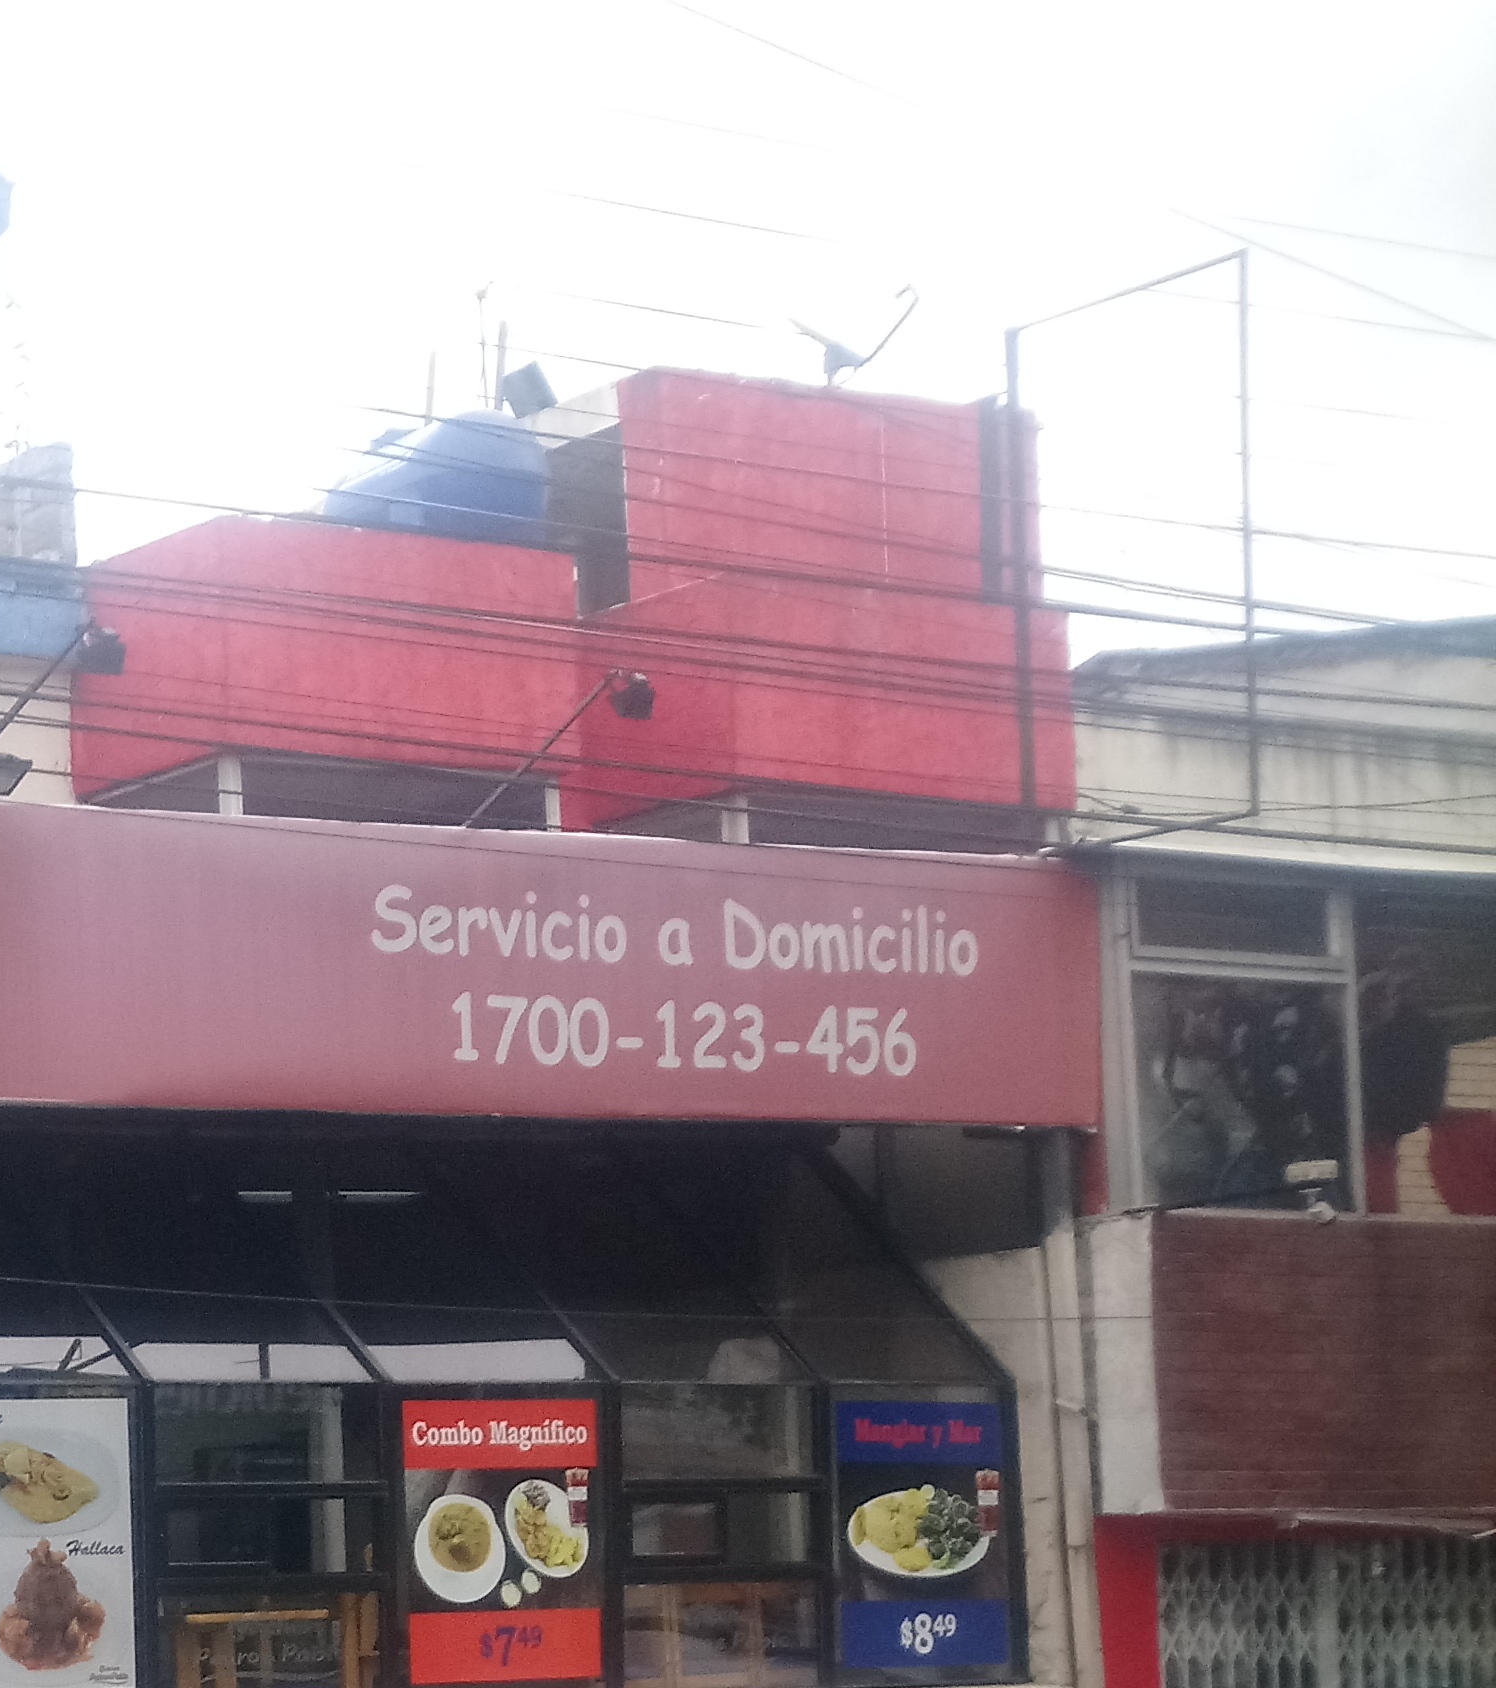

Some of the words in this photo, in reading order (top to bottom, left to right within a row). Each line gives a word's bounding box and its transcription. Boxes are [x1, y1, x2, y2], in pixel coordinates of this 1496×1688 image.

[371, 884, 627, 964] Servicio
[658, 917, 693, 966] a
[724, 898, 979, 977] Domicilio
[452, 990, 918, 1077] 1700-123-456
[411, 1419, 484, 1446] Combo
[488, 1418, 588, 1452] Magnífico
[65, 1539, 126, 1557] Hallaca
